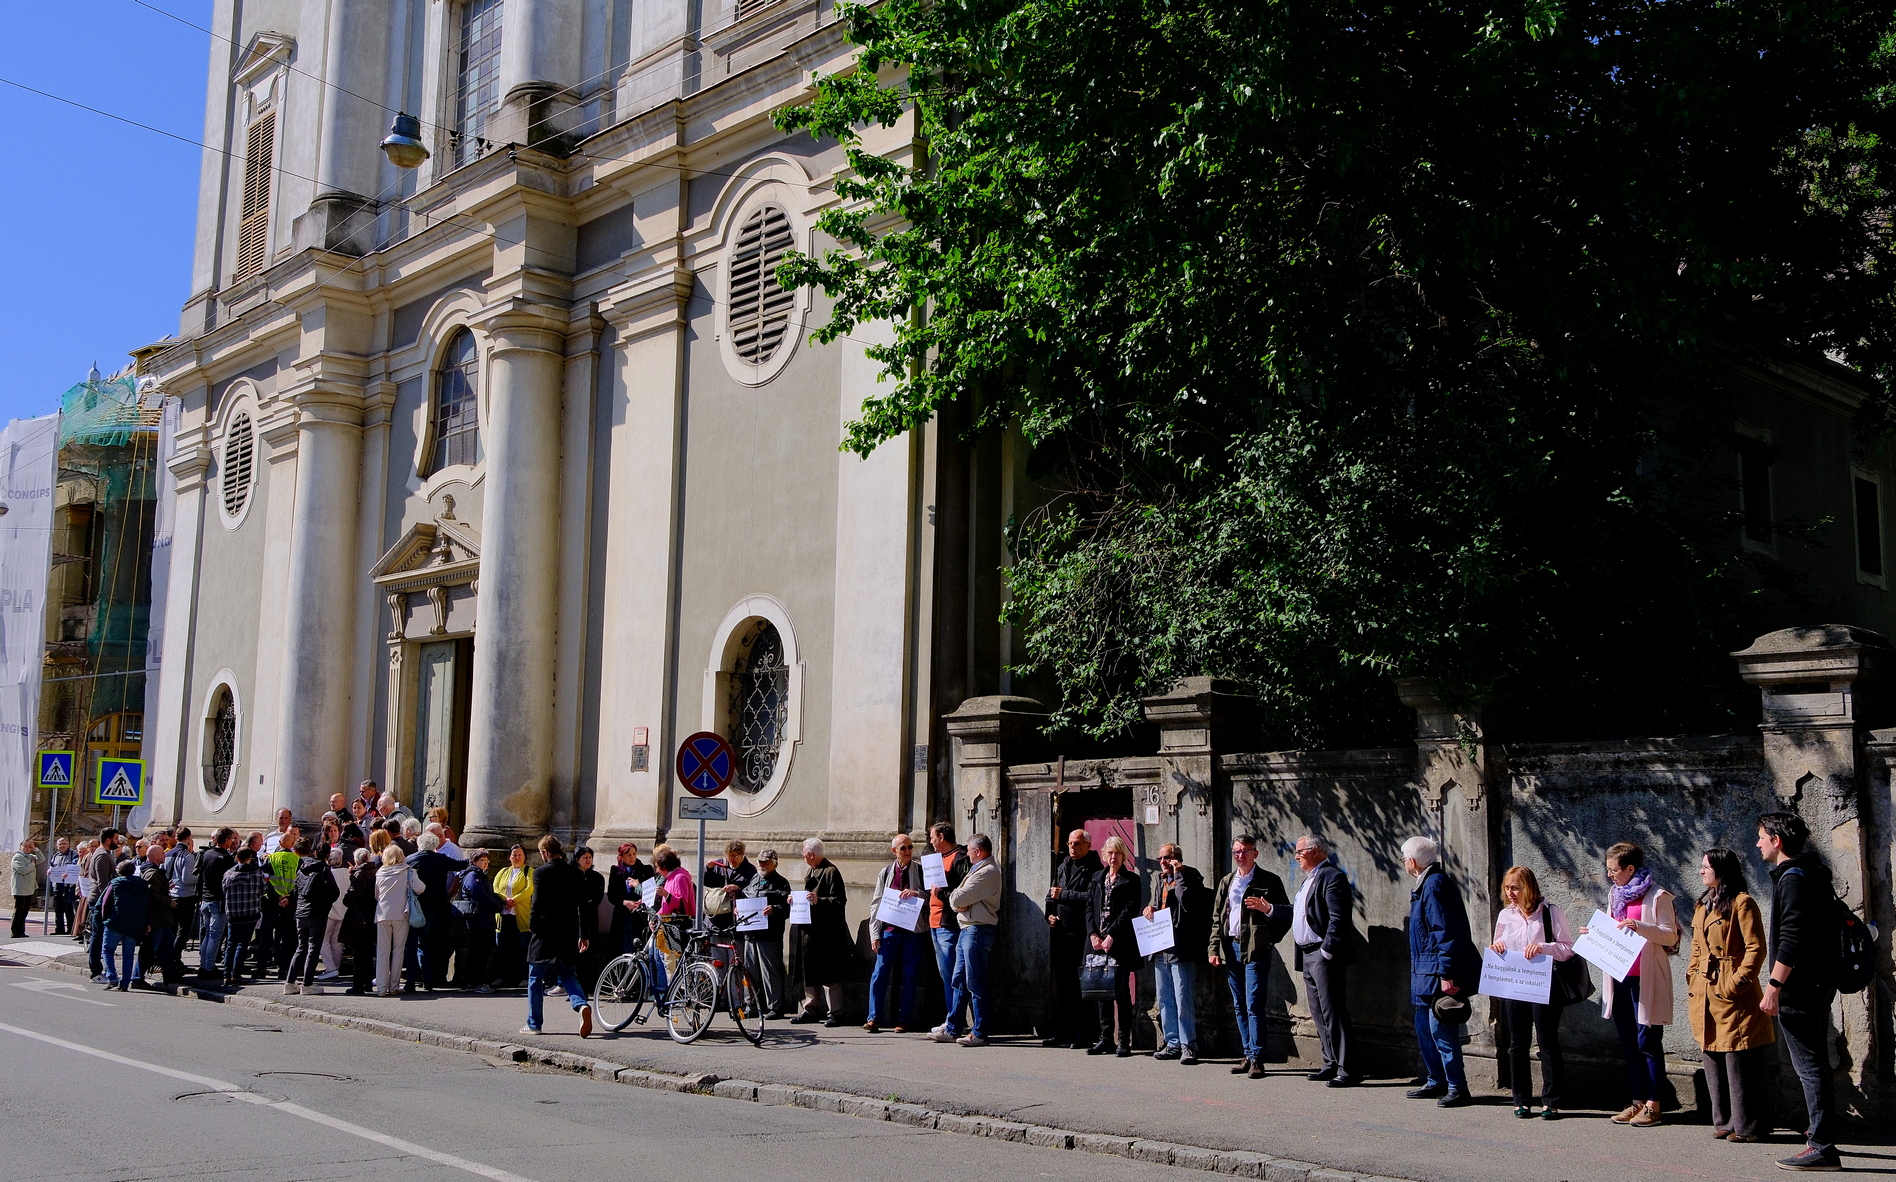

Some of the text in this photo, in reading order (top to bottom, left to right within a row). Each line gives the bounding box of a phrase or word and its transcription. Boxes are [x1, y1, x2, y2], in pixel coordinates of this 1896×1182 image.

[8, 488, 51, 499] CONGIPS
[1, 589, 33, 613] PLA
[1144, 785, 1160, 805] 16
[1149, 810, 1156, 821] 16
